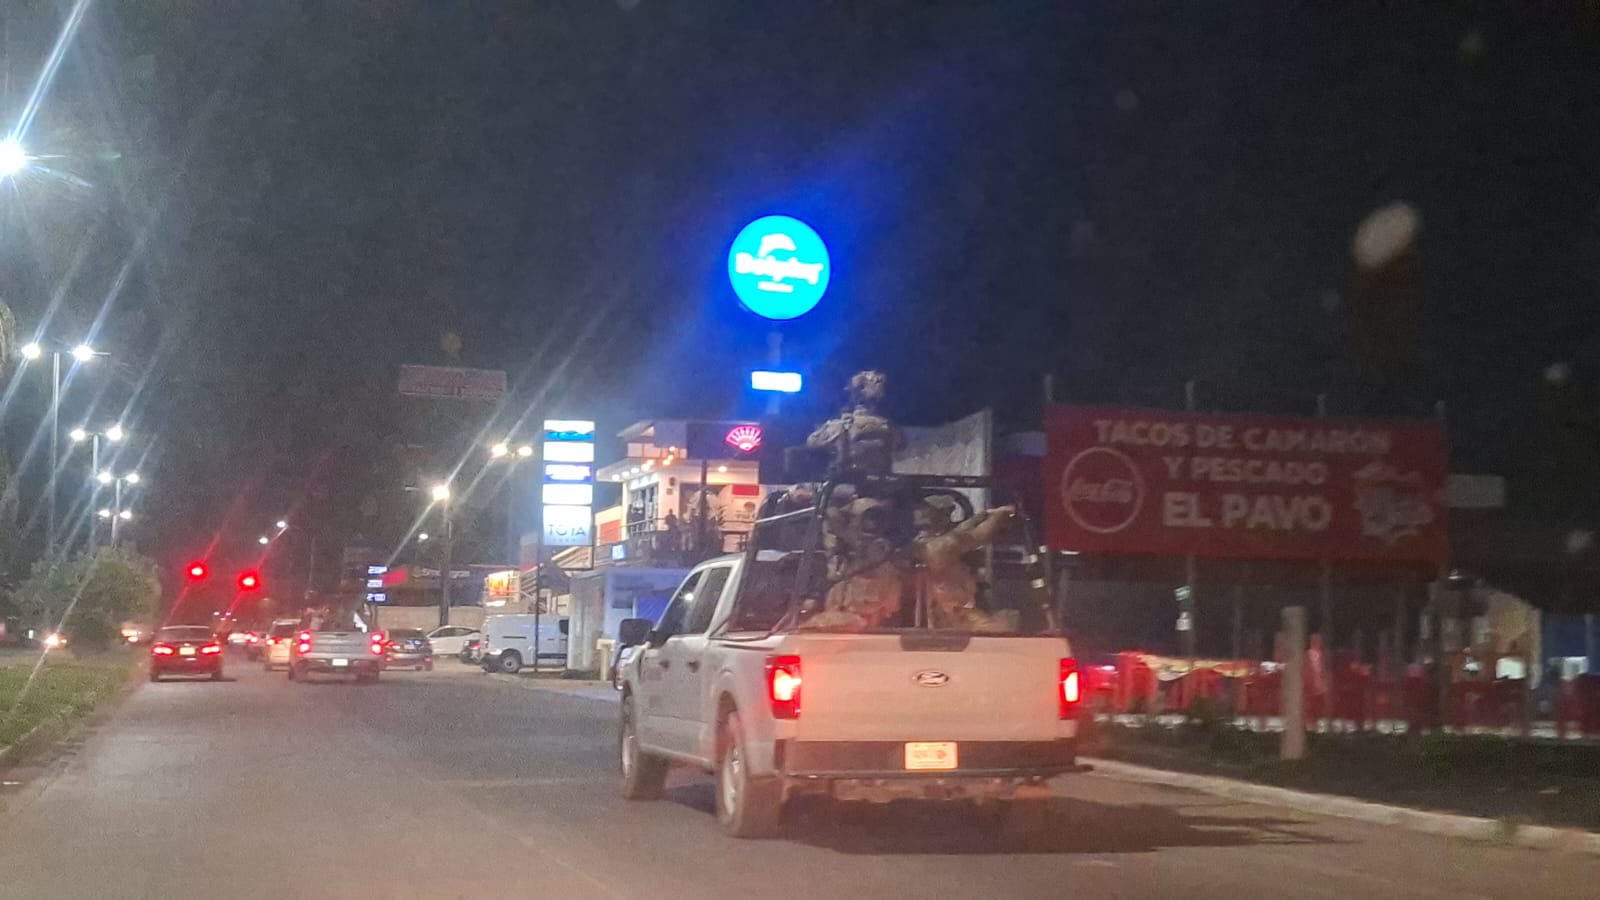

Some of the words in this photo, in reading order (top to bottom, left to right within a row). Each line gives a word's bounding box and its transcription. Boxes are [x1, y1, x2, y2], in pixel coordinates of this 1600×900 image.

[1095, 420, 1188, 446] TACOS
[1197, 424, 1235, 448] DE
[1162, 456, 1185, 479] Y
[1190, 457, 1328, 484] PESCADO
[1162, 491, 1211, 527] EL
[1221, 493, 1332, 531] PAVO
